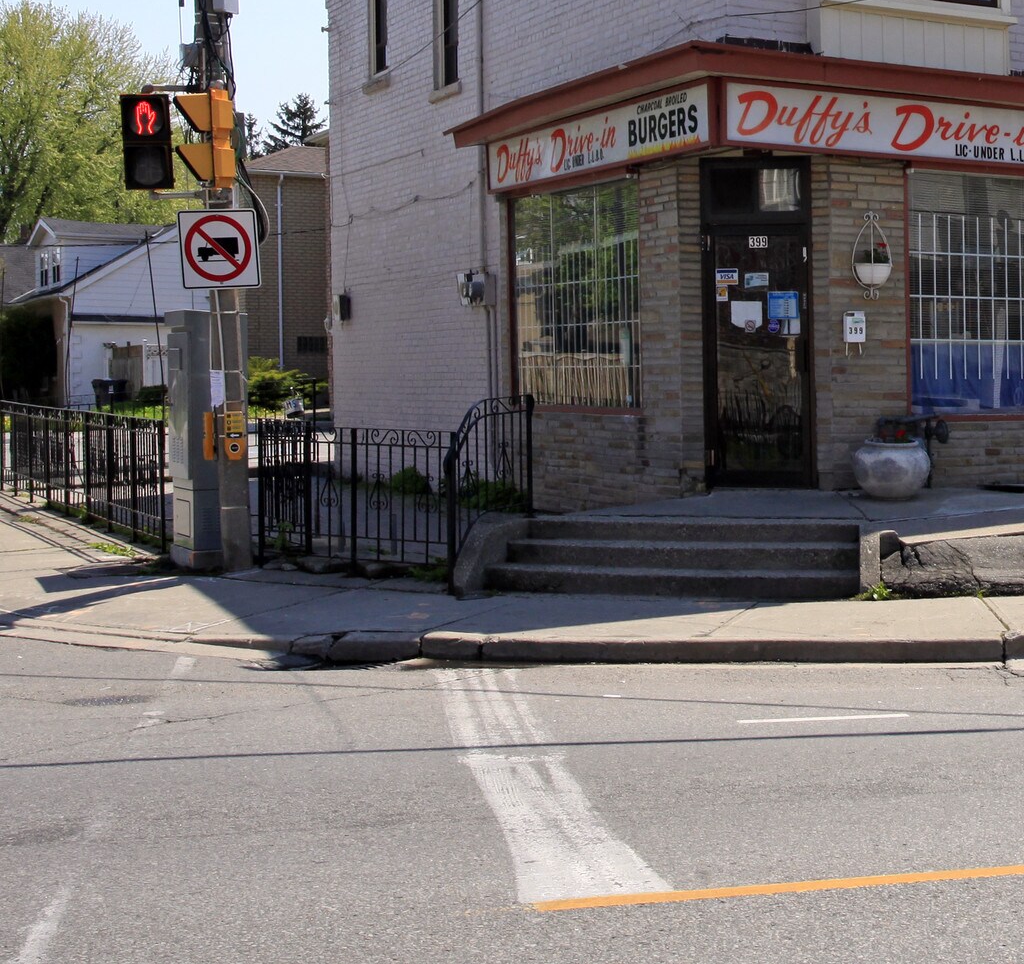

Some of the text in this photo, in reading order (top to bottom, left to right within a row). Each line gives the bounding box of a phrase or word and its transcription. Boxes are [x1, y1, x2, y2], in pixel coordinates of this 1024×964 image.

[665, 92, 688, 107] BROILED
[628, 104, 698, 147] BURGERS
[736, 91, 873, 147] Duffy's
[496, 116, 616, 183] Duffy's Drive-in
[750, 237, 768, 248] 399
[848, 327, 864, 335] 399
